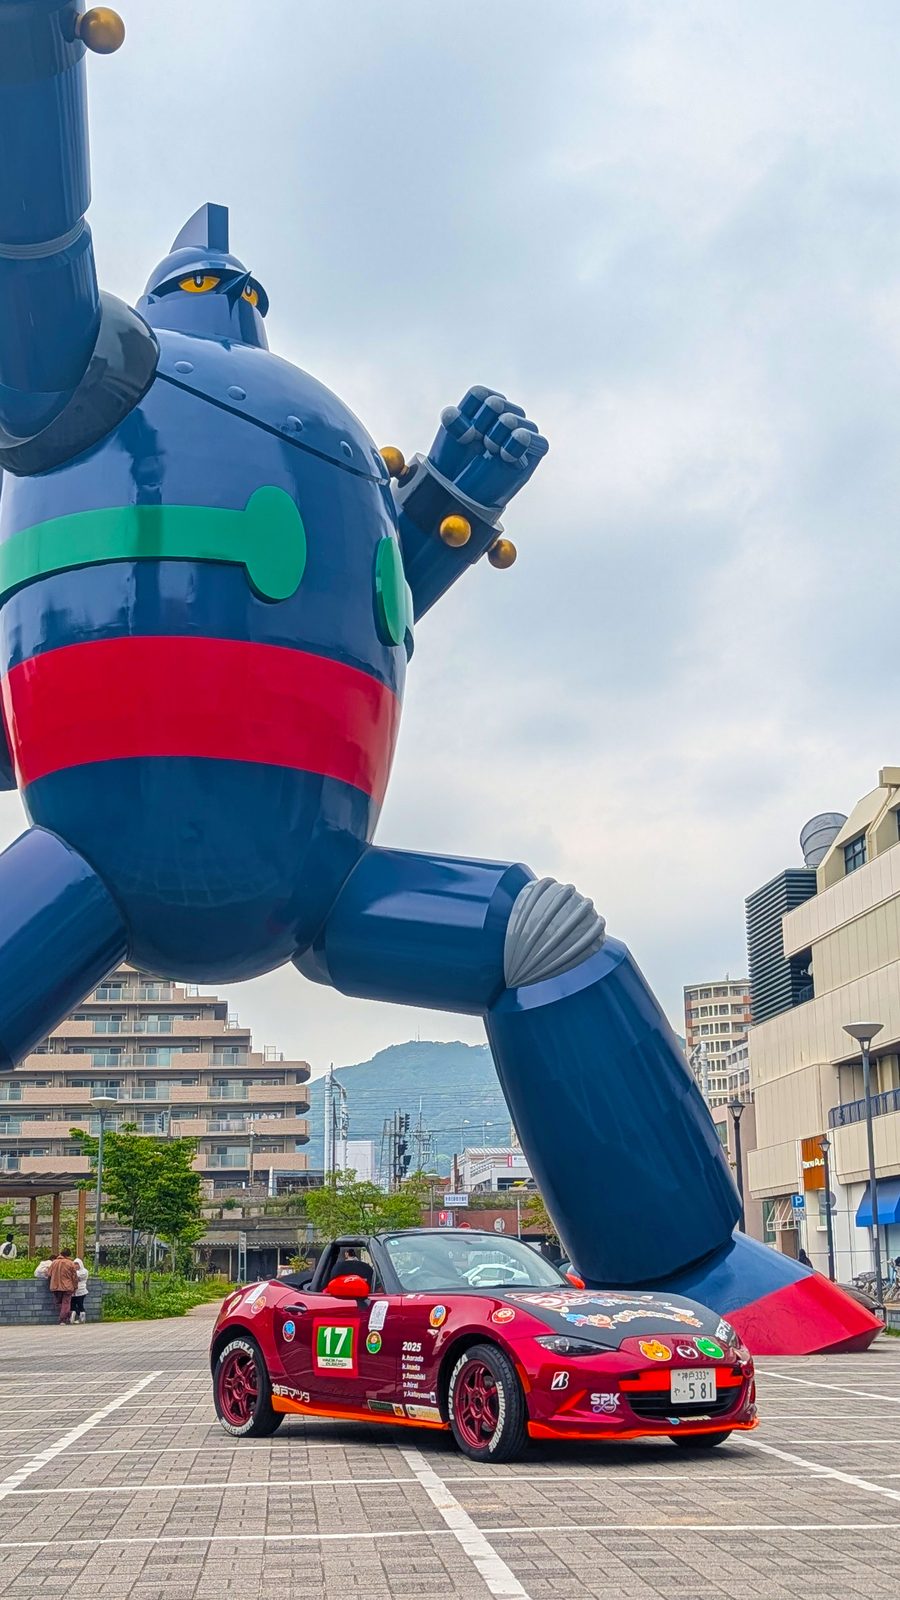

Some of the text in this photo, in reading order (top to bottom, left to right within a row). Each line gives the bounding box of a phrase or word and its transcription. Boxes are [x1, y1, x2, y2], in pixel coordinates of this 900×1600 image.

[795, 1196, 803, 1206] P
[323, 1327, 348, 1354] 17
[220, 1340, 254, 1363] POTENZA
[402, 1342, 422, 1352] 2025
[590, 1393, 620, 1404] SPK
